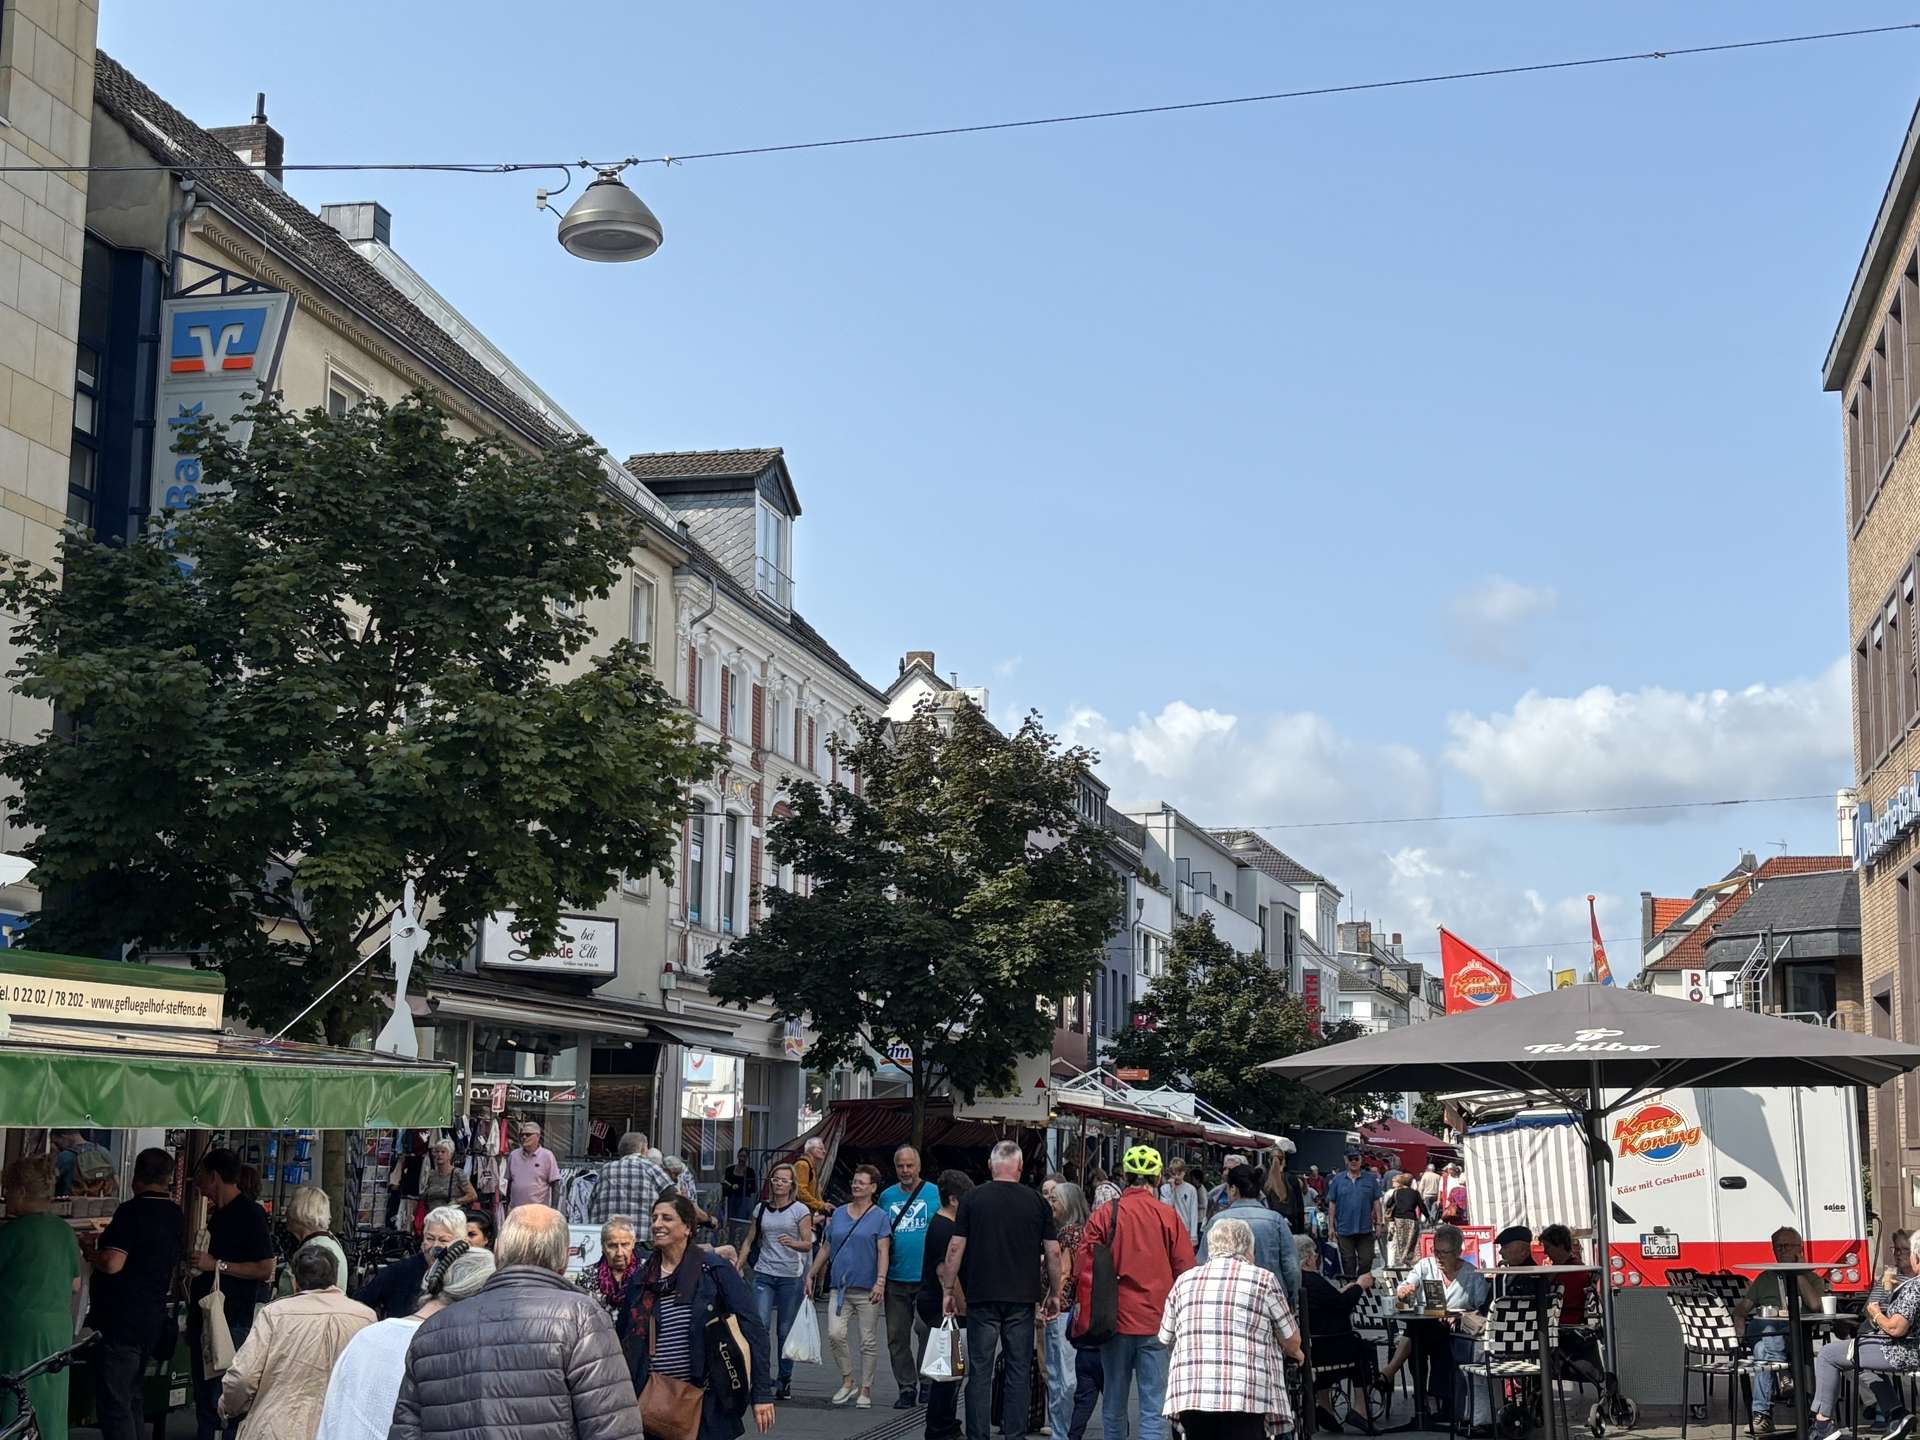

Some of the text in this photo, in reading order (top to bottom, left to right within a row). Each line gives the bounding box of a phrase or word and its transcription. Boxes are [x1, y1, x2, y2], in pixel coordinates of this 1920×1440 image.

[165, 400, 203, 510] Bak
[580, 927, 596, 941] bei
[579, 943, 599, 960] Elli
[0, 986, 10, 1000] el.
[14, 987, 19, 1001] 0
[21, 988, 33, 1003] 22
[35, 989, 46, 1004] 02
[55, 991, 66, 1006] 78
[67, 992, 84, 1008] 202
[91, 996, 207, 1018] www.gefluegelhof-steffens.de
[1523, 1042, 1661, 1054] Tchibo
[1612, 1111, 1683, 1140] Kaas
[1618, 1126, 1702, 1158] Koning
[1617, 1167, 1706, 1195] Käse mit Geschmack!
[1644, 1245, 1677, 1255] GL 2018
[1648, 1236, 1658, 1246] ME
[719, 1341, 741, 1390] DEPOT
